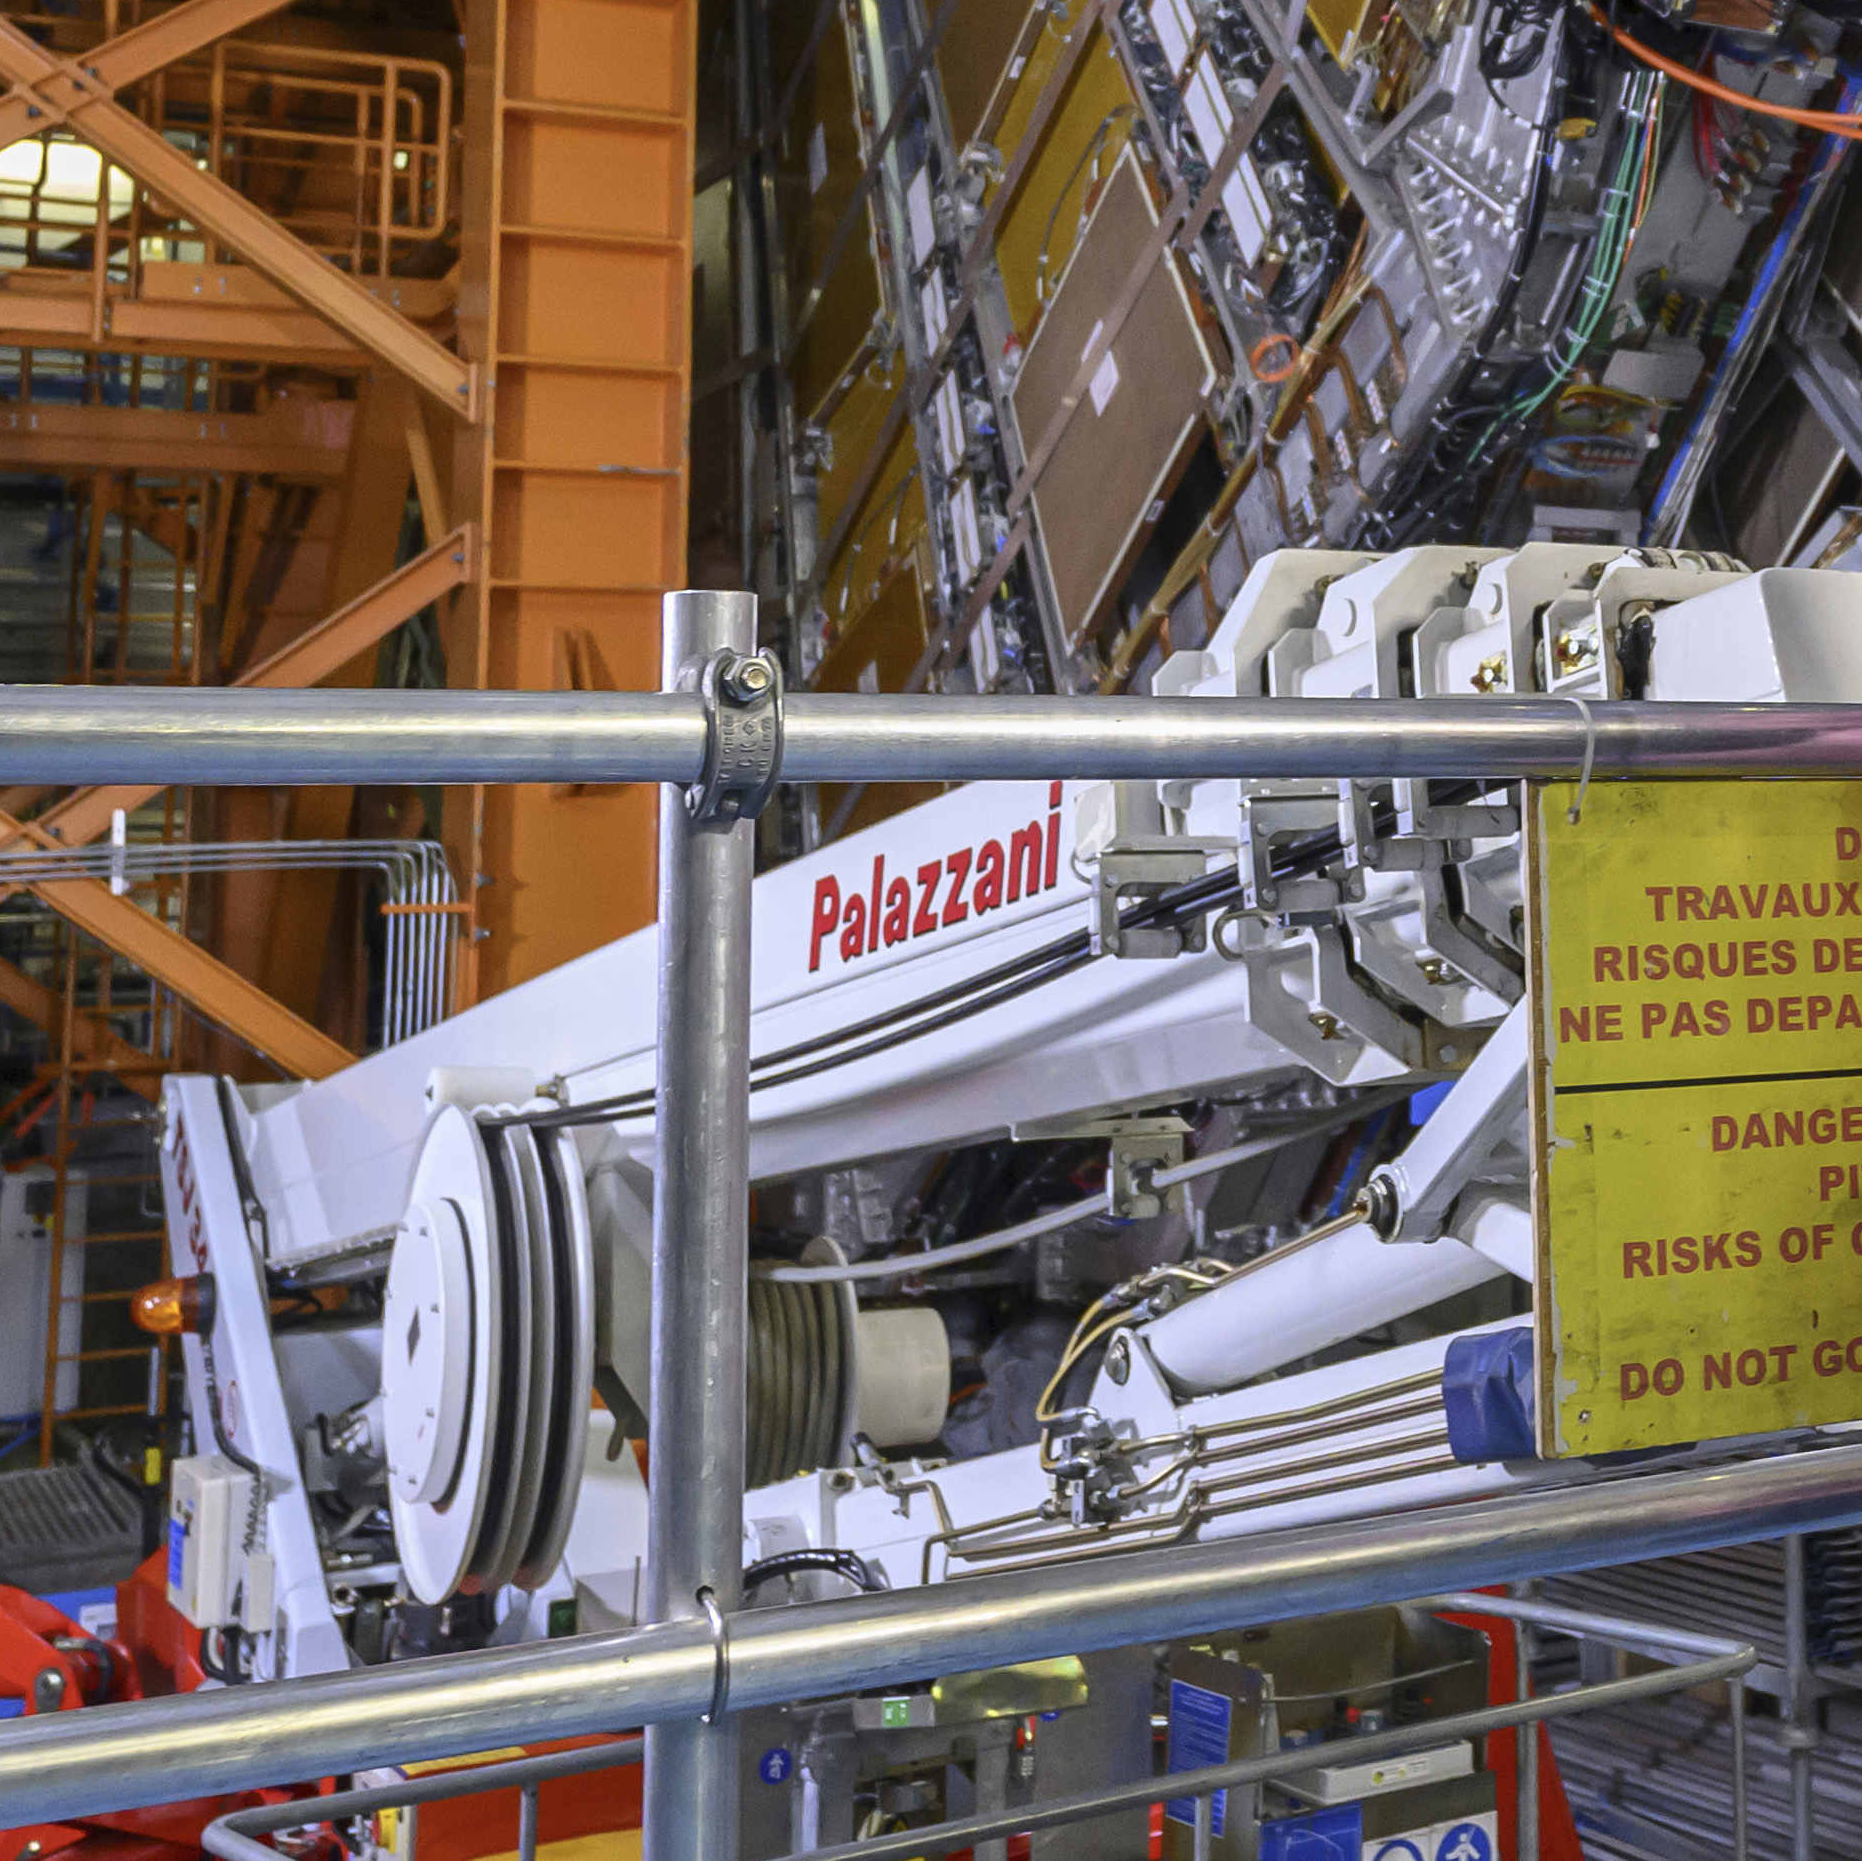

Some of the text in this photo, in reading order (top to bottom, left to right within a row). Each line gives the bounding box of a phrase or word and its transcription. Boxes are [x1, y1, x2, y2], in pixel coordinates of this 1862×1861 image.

[808, 780, 1063, 973] Palazzani
[1645, 881, 1862, 922] TRAVAUX
[1594, 939, 1796, 982] RISQUES
[1559, 1004, 1623, 1042] NE
[1641, 999, 1731, 1039] PAS
[1622, 1229, 1763, 1279] RISKS
[1778, 1223, 1835, 1264] OF
[1620, 1358, 1685, 1401] DO
[1703, 1344, 1797, 1391] NOT
